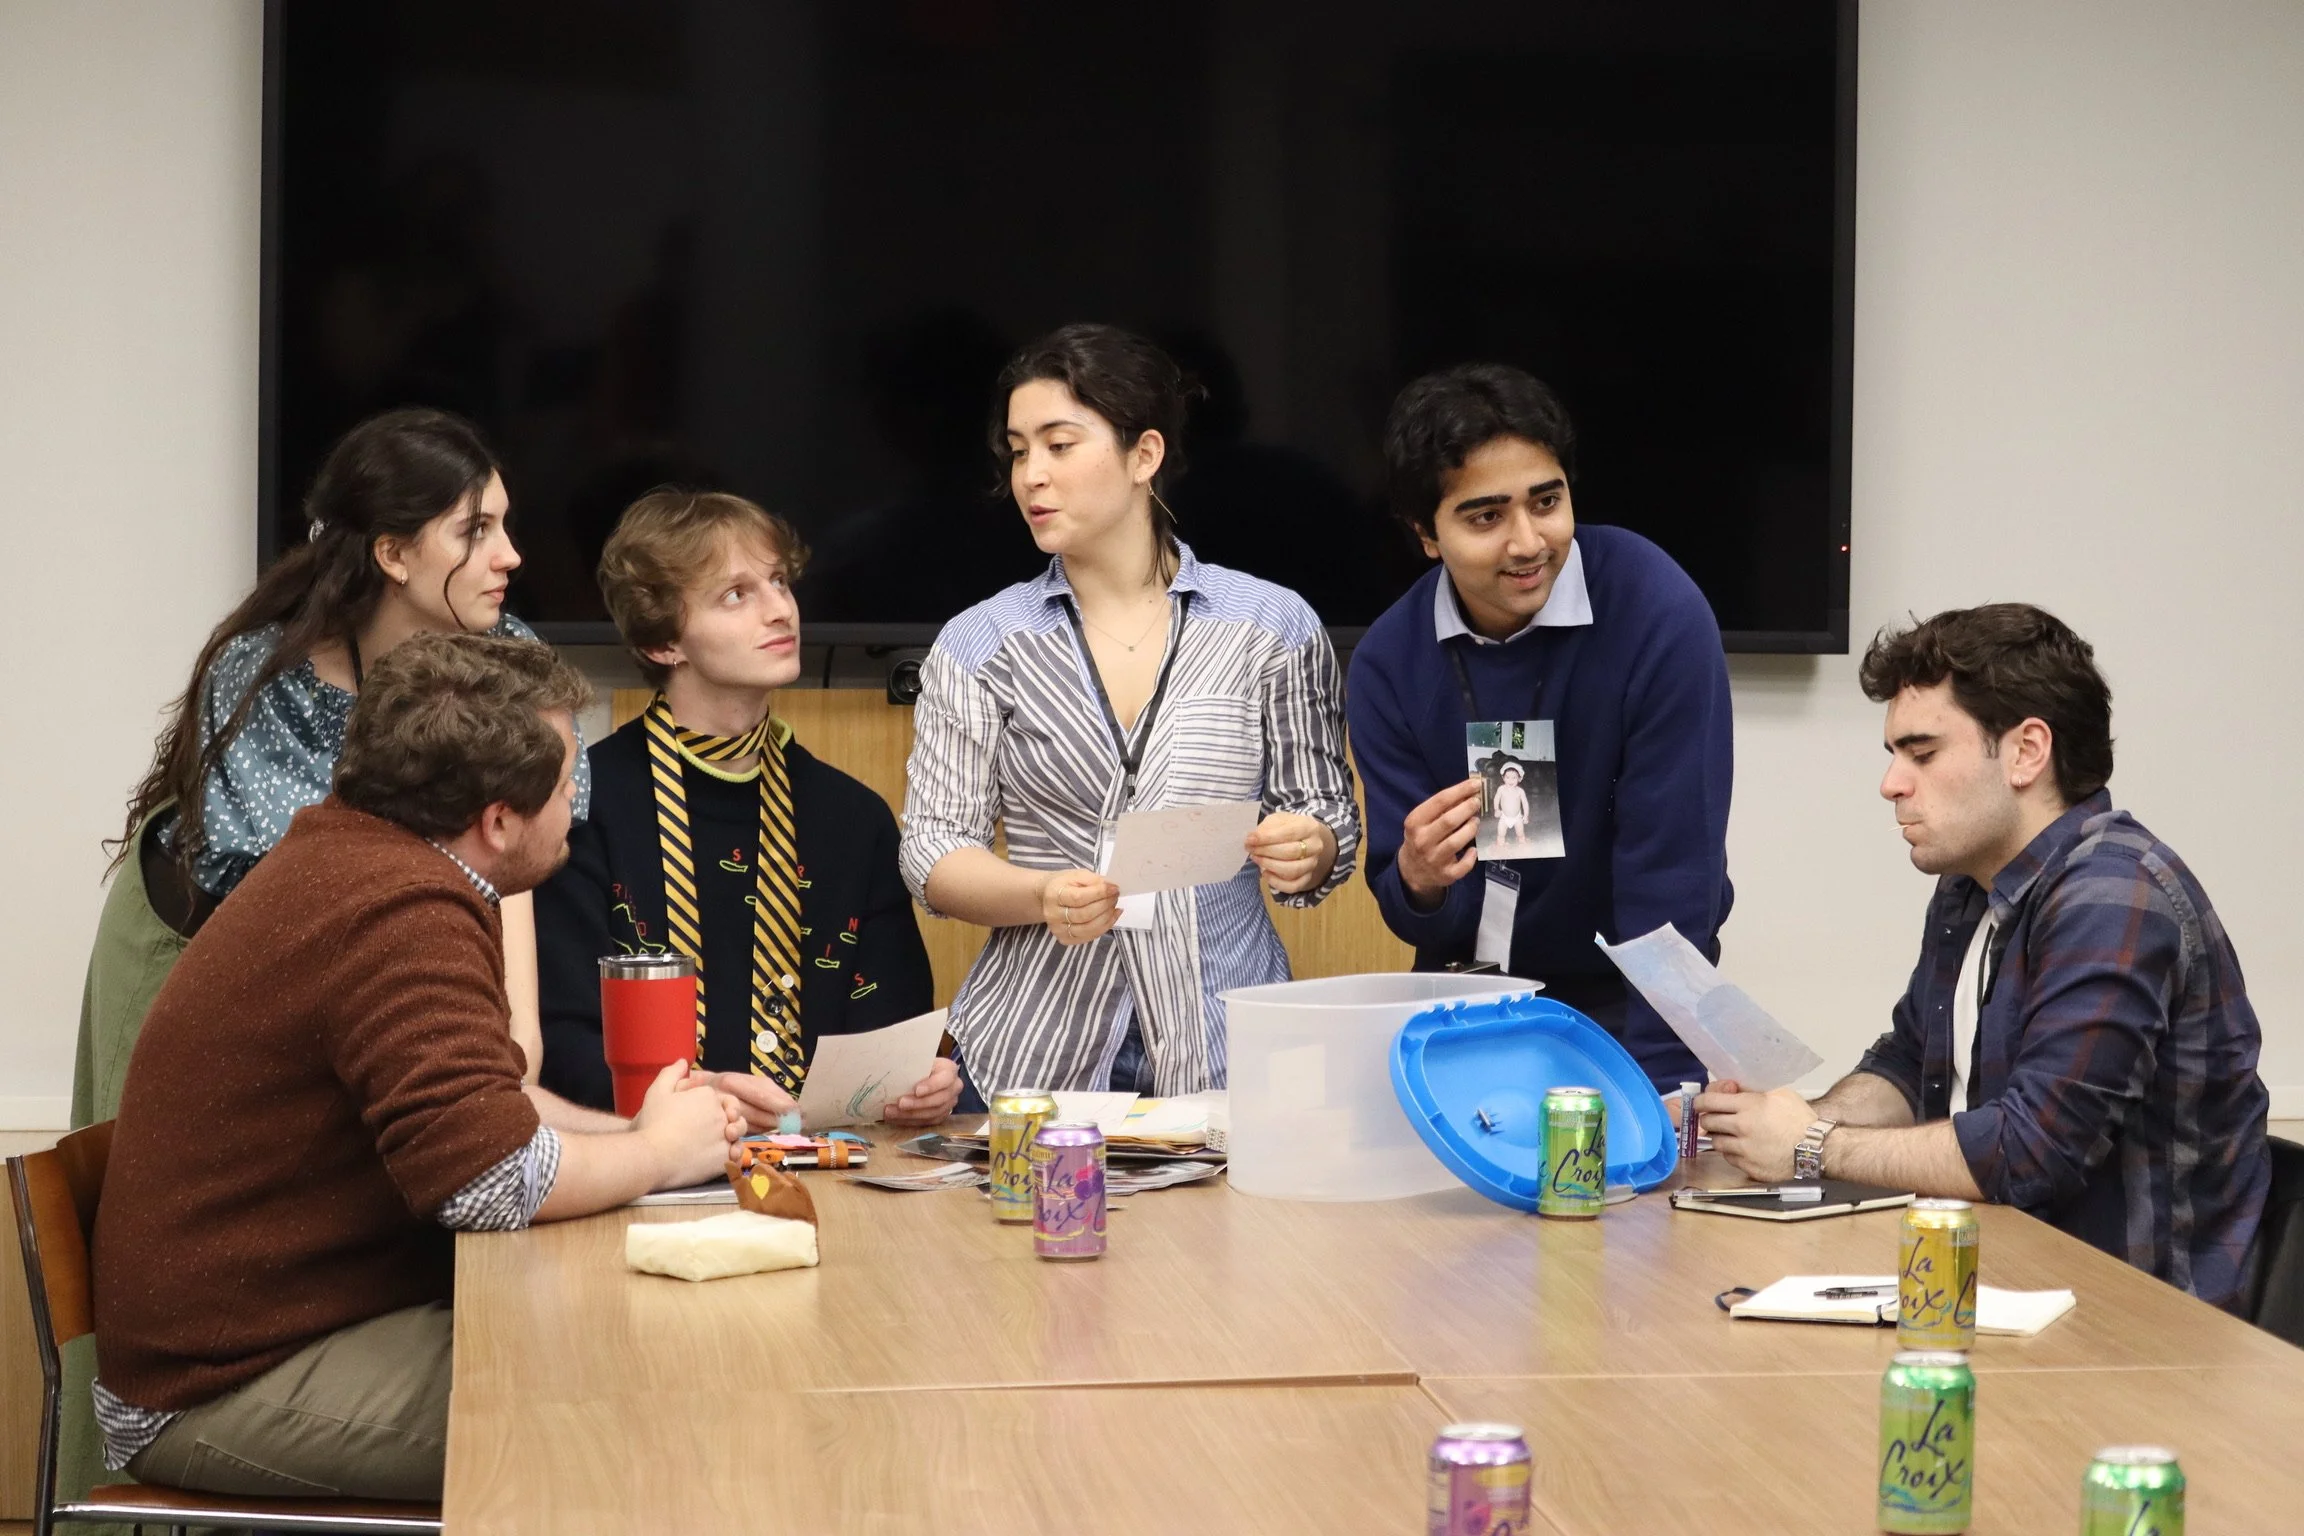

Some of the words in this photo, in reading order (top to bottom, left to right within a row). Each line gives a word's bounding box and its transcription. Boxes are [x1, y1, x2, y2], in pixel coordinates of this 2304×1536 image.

[848, 917, 859, 932] N
[1045, 1154, 1075, 1199] La
[1902, 1235, 1935, 1286] La
[1900, 1287, 1945, 1320] oix
[1911, 1398, 1955, 1458] La
[1879, 1439, 1965, 1500] Croix
